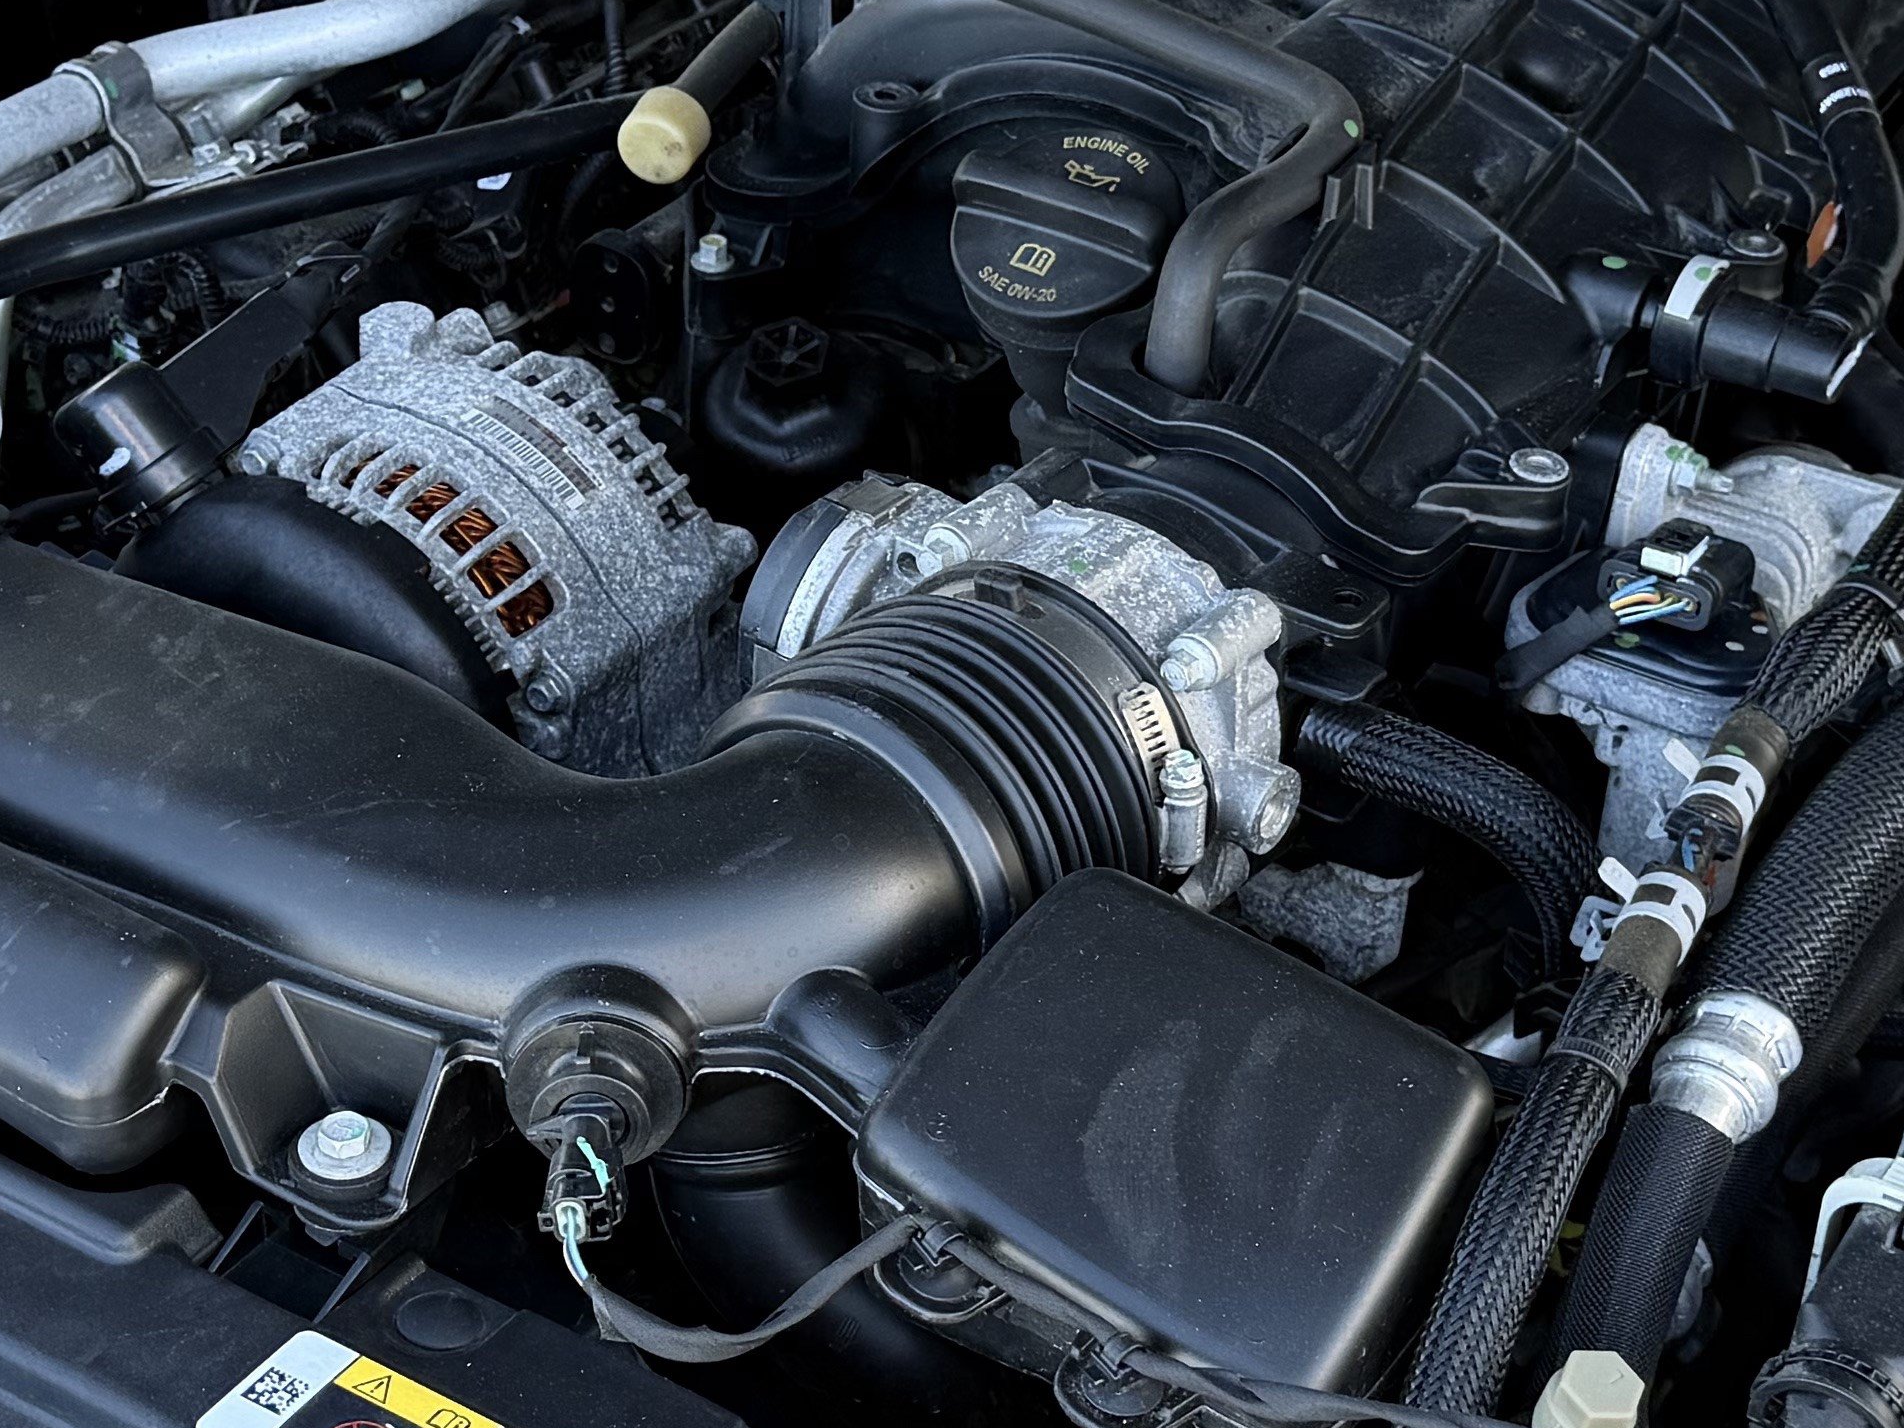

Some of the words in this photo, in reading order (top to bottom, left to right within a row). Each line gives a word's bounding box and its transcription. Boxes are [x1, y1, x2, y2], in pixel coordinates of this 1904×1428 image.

[1063, 136, 1129, 157] ENGINE
[1126, 152, 1150, 174] OIL
[978, 265, 1010, 292] SAE
[1007, 283, 1057, 302] 0W-20
